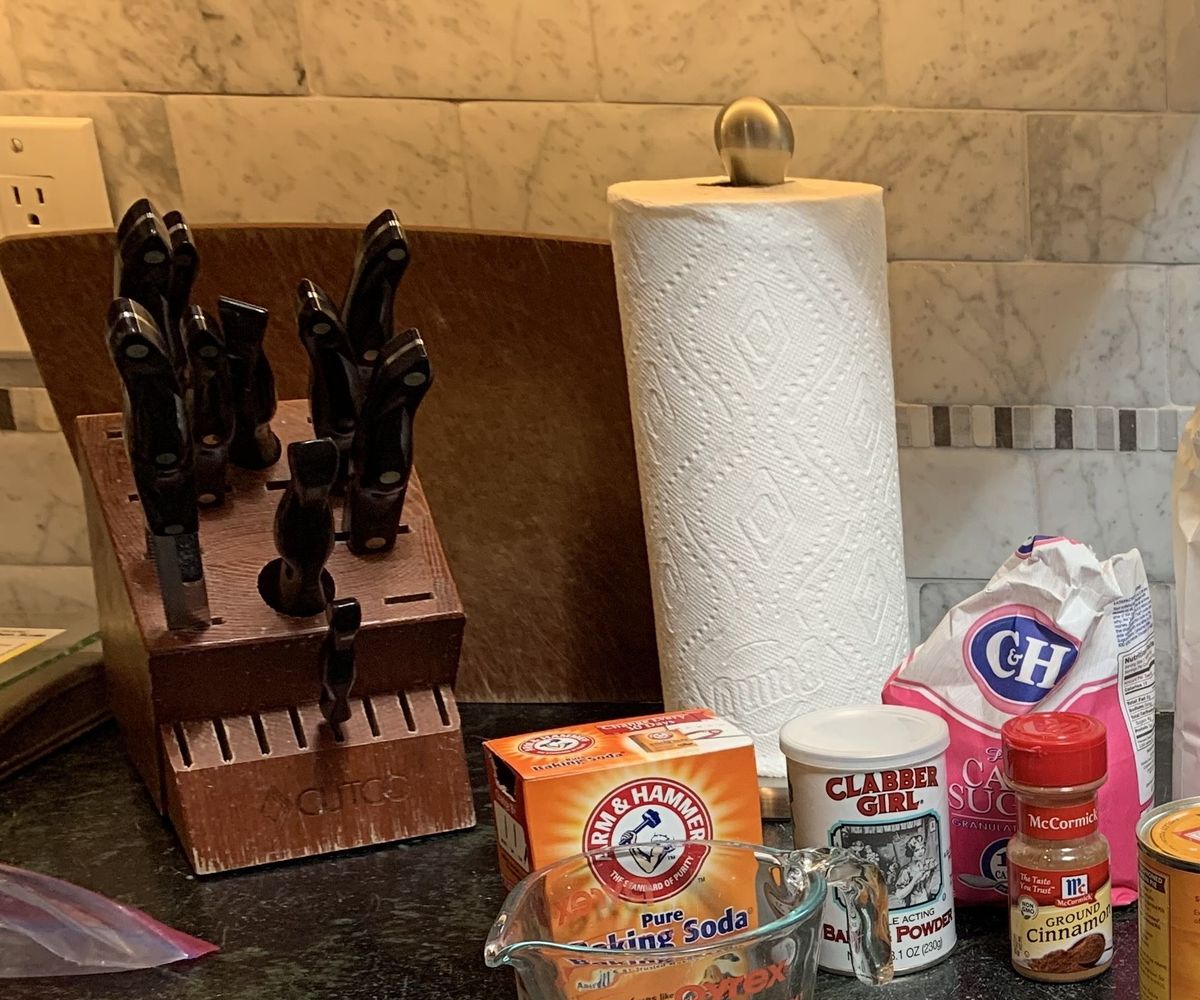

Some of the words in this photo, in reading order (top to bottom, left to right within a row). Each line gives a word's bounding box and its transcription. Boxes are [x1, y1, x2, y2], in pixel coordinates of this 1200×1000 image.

[986, 630, 1071, 689] C&H
[825, 765, 939, 801] CLABBER
[962, 757, 1011, 791] CA
[631, 784, 707, 842] HAMMER
[856, 790, 920, 817] GIRL
[948, 783, 1017, 816] SUG
[1027, 807, 1099, 831] McCormick
[664, 878, 675, 888] OF
[674, 855, 695, 881] PURITY
[641, 908, 684, 928] Pure
[684, 907, 748, 943] Soda
[896, 908, 953, 943] POWDER
[902, 907, 936, 923] ACTING
[1026, 903, 1111, 944] Cinnamon
[1045, 902, 1101, 928] GROUND
[906, 945, 921, 958] OZ
[921, 936, 943, 957] (230g)
